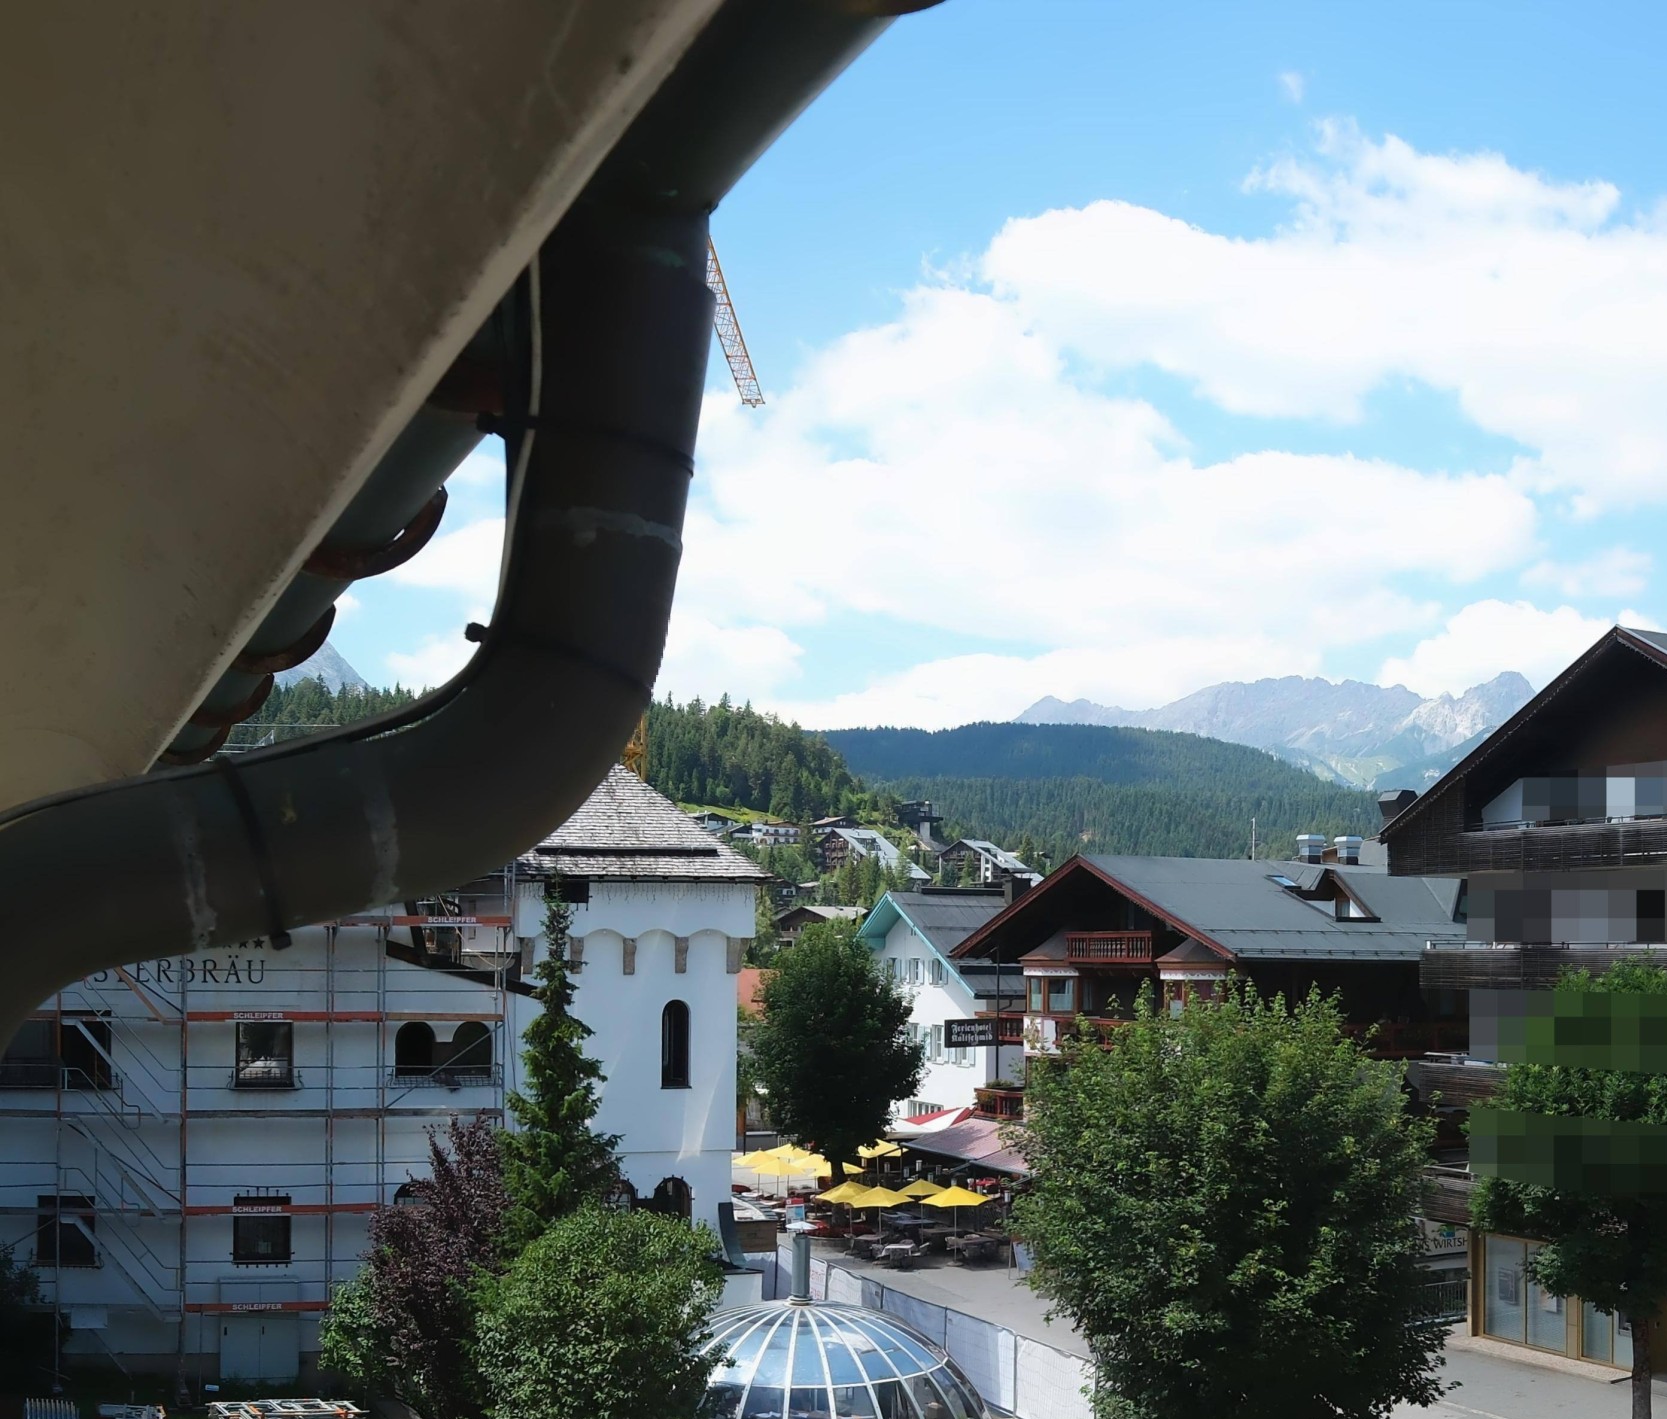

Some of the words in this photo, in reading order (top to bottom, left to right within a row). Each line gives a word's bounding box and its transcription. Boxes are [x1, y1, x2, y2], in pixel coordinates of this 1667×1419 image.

[427, 916, 477, 924] SCHLEIPFER
[94, 954, 266, 985] SERBRÄU
[233, 1012, 284, 1020] SCHLEIPFER
[232, 1206, 283, 1214] SCHLEIPFER
